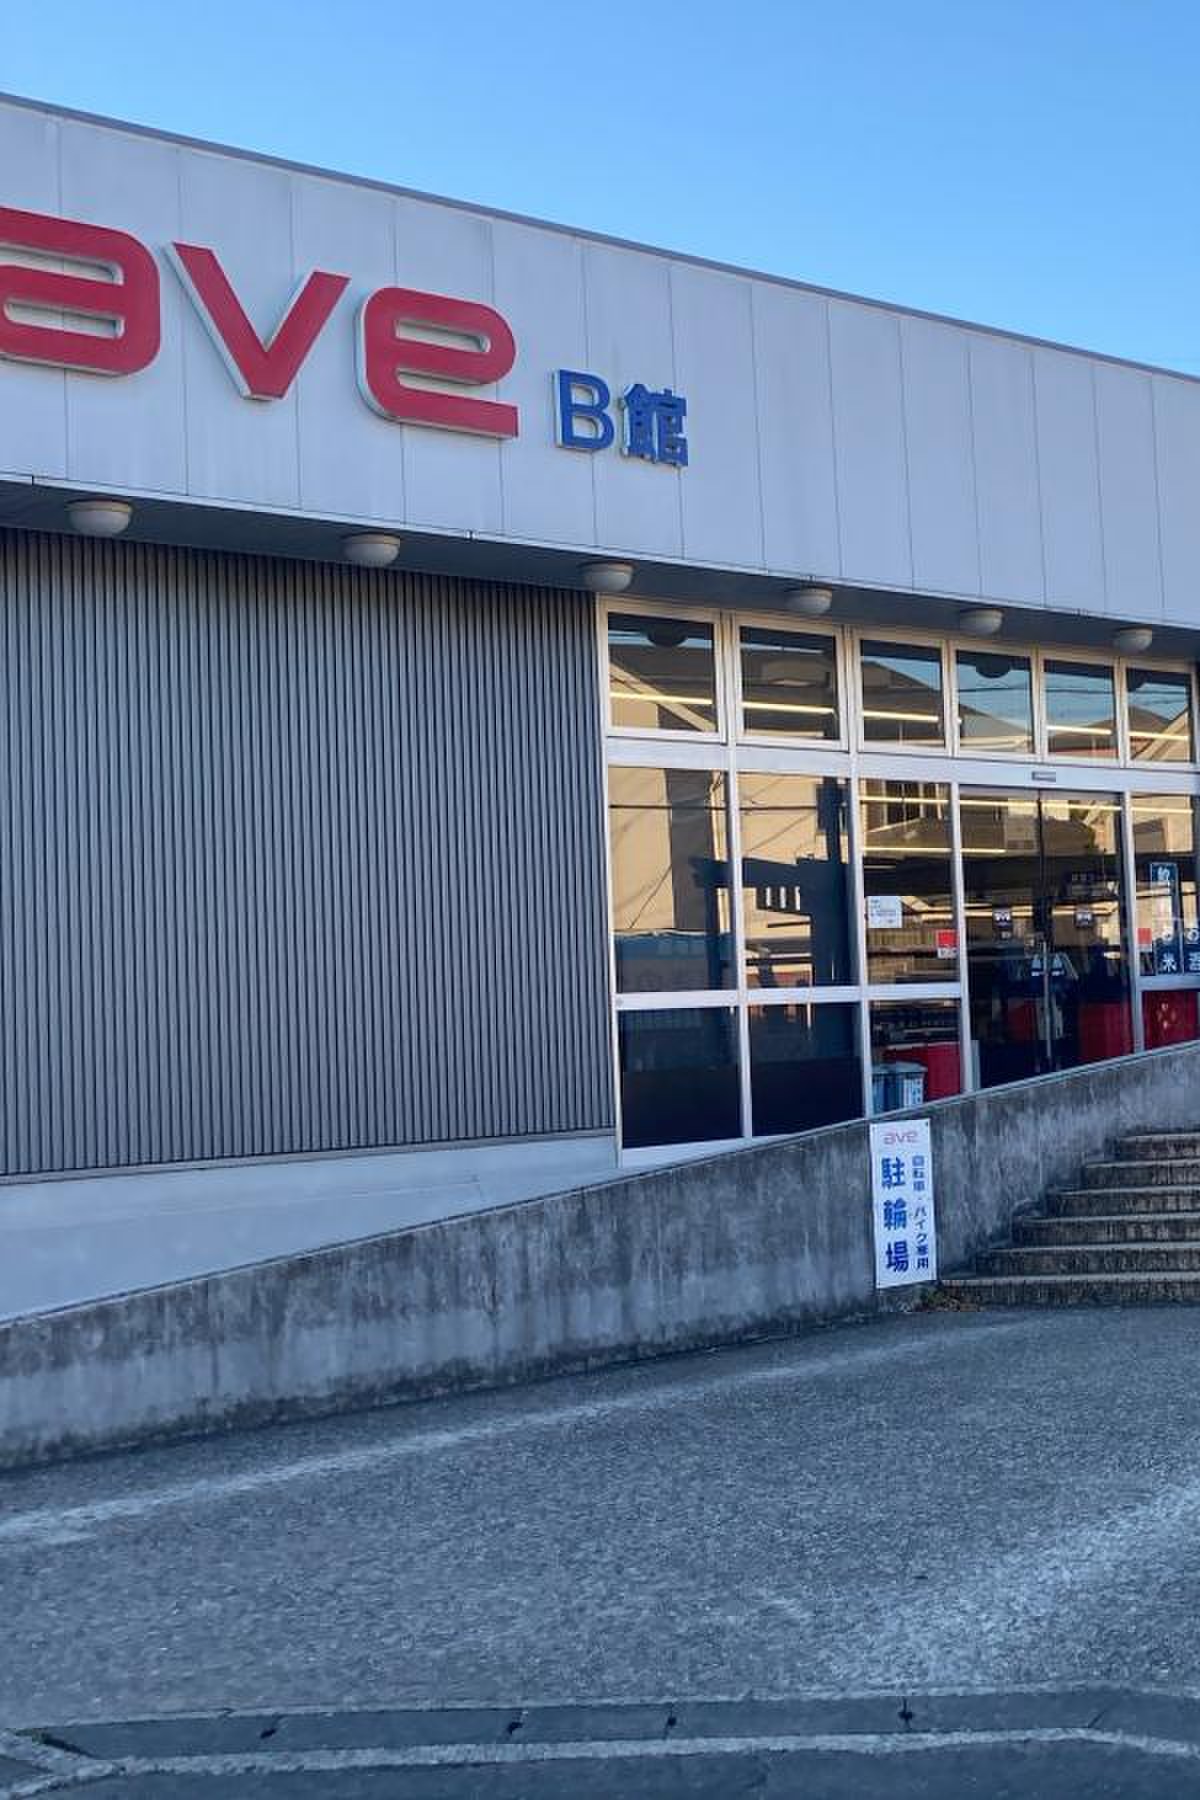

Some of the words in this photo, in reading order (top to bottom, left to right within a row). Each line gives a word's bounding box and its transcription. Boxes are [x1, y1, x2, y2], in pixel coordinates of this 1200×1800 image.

[0, 207, 519, 438] ave
[553, 368, 689, 466] B館
[882, 1130, 919, 1145] ave
[881, 1156, 909, 1272] 駐輪場
